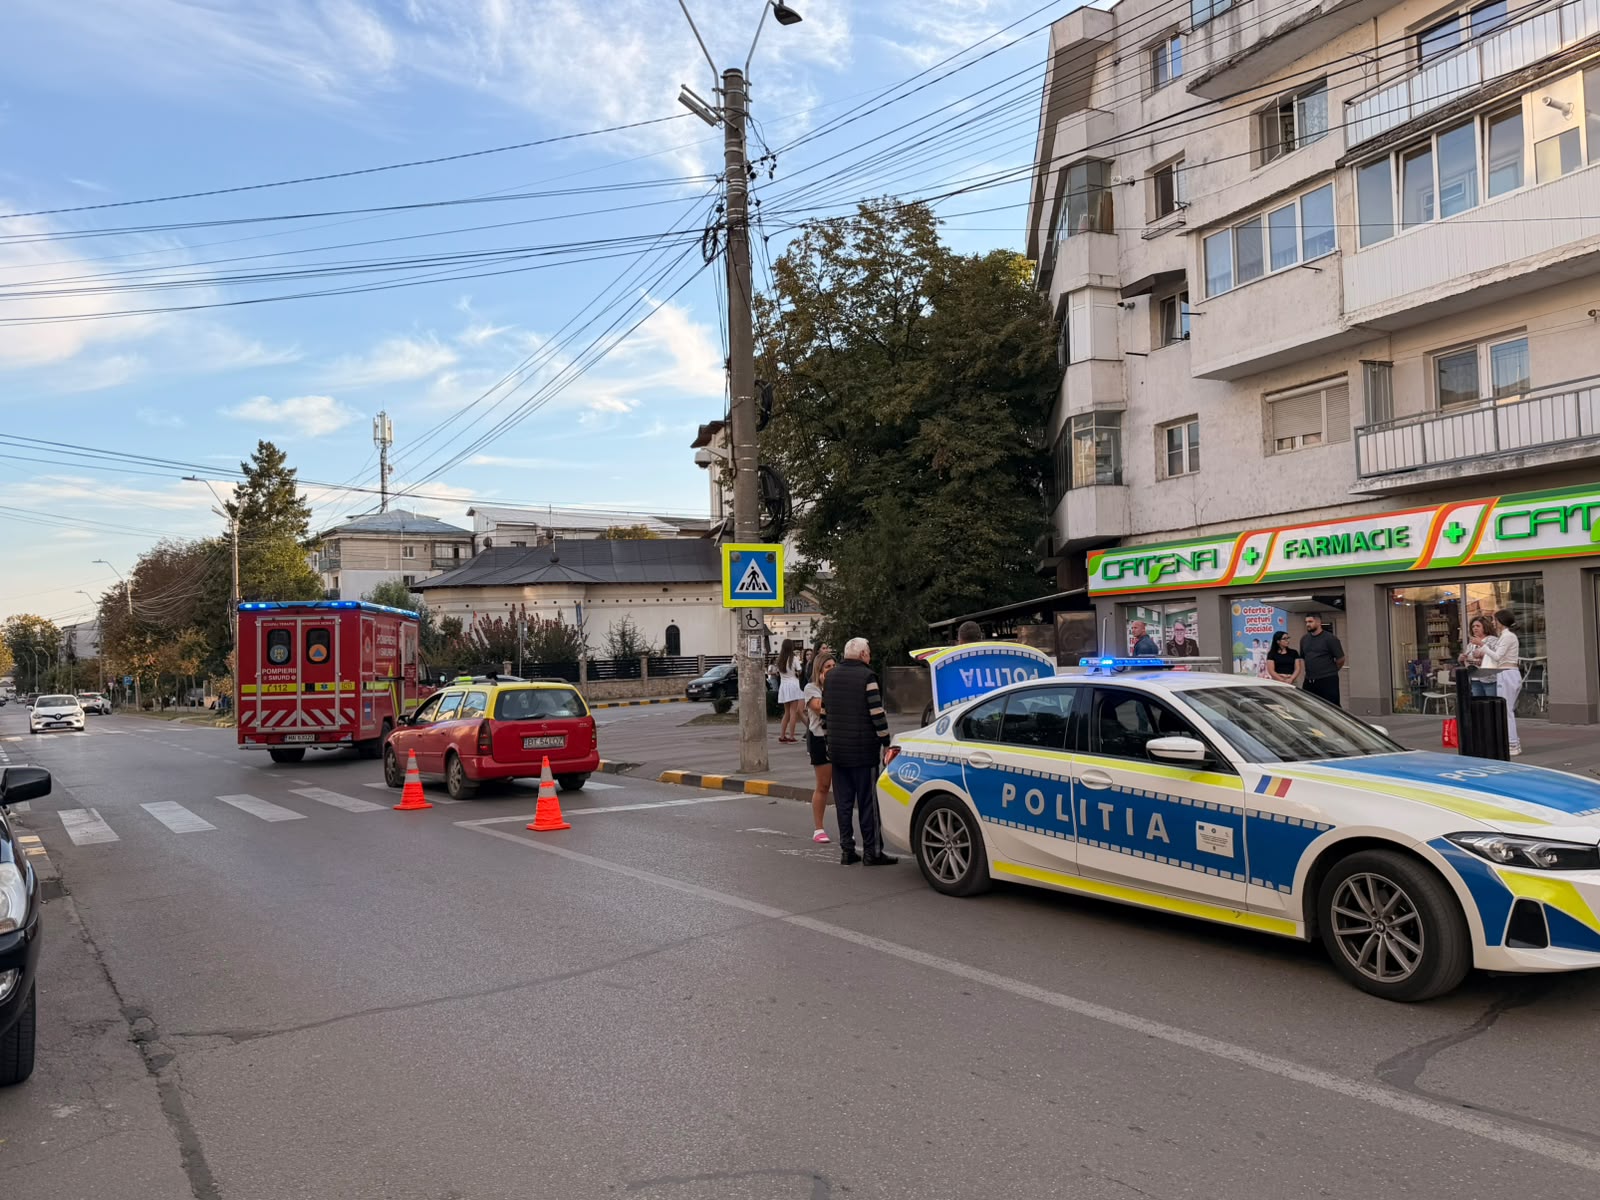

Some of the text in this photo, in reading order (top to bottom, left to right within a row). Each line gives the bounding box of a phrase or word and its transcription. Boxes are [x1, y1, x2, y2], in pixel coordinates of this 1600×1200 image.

[1495, 502, 1600, 542] CAT
[1283, 526, 1410, 559] FARMACIE
[1102, 549, 1217, 583] CATENA
[274, 684, 288, 692] 112
[959, 667, 1039, 688] POLITIA
[1002, 783, 1170, 843] POLITIA
